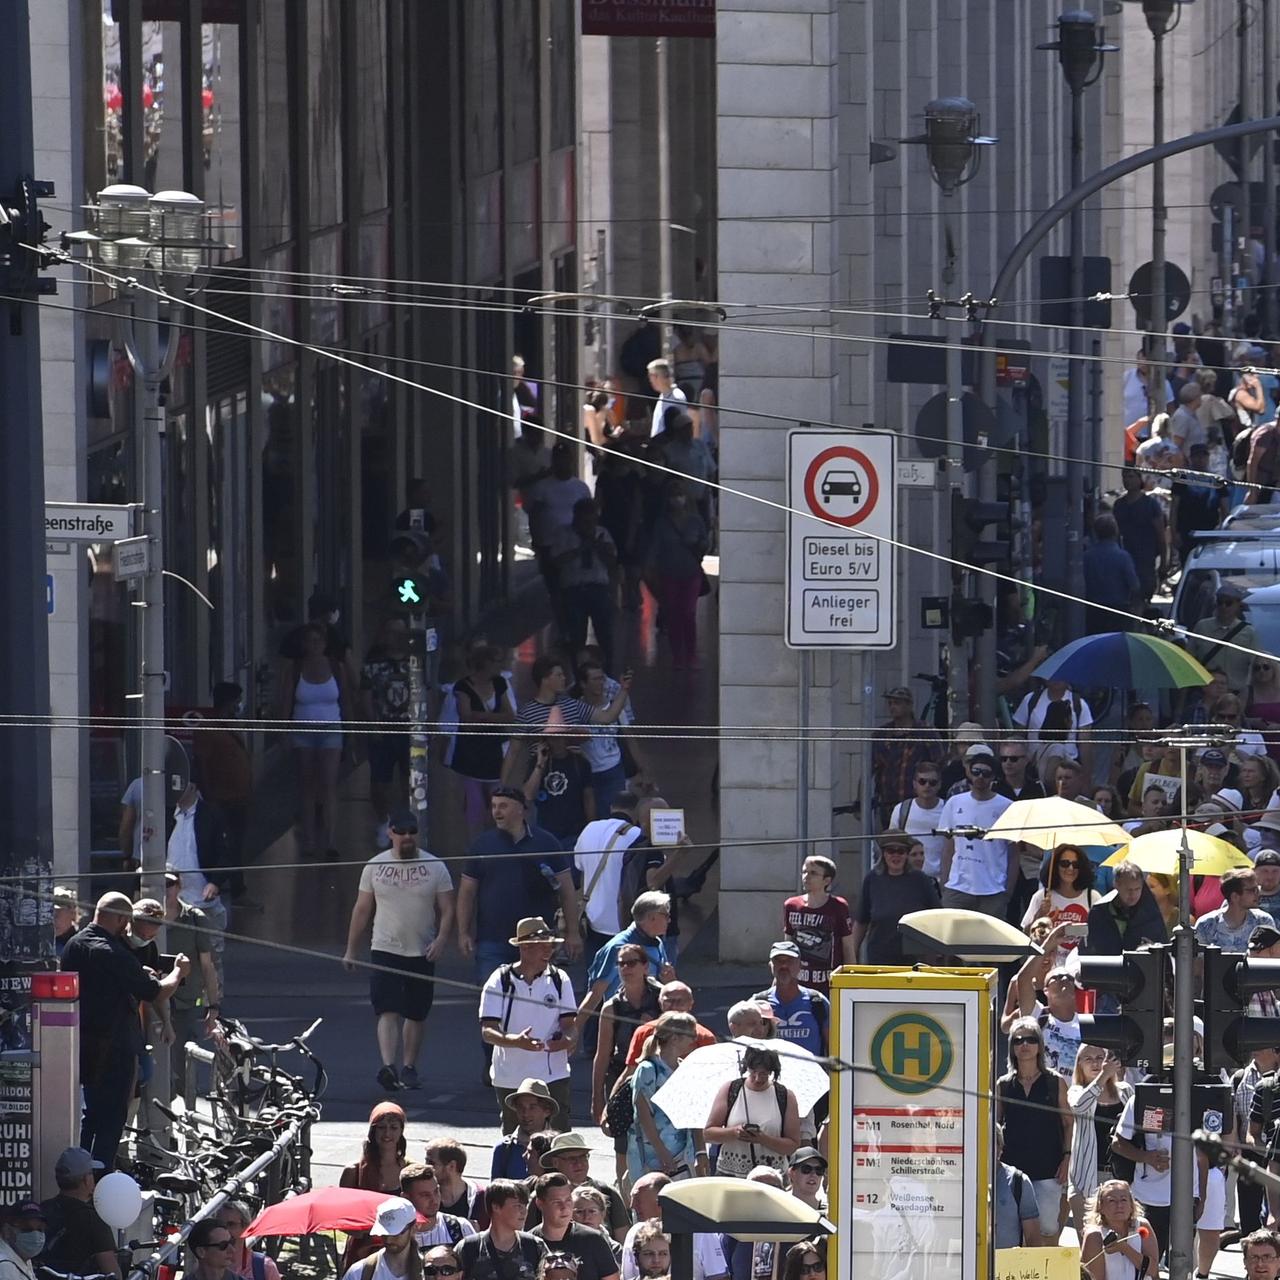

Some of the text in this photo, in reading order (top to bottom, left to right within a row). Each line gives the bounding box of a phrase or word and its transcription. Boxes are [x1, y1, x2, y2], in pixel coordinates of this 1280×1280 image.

[808, 542, 874, 556] Diesel bis
[810, 562, 872, 576] Euro 5/V
[811, 594, 871, 612] Anlieger
[829, 613, 853, 627] frei
[893, 1032, 929, 1076] H
[1137, 1059, 1150, 1068] F5
[865, 1121, 881, 1131] M1
[934, 1120, 956, 1131] Nord
[890, 1167, 945, 1177] Schillerstraße
[866, 1193, 935, 1204] 12 Weißensee
